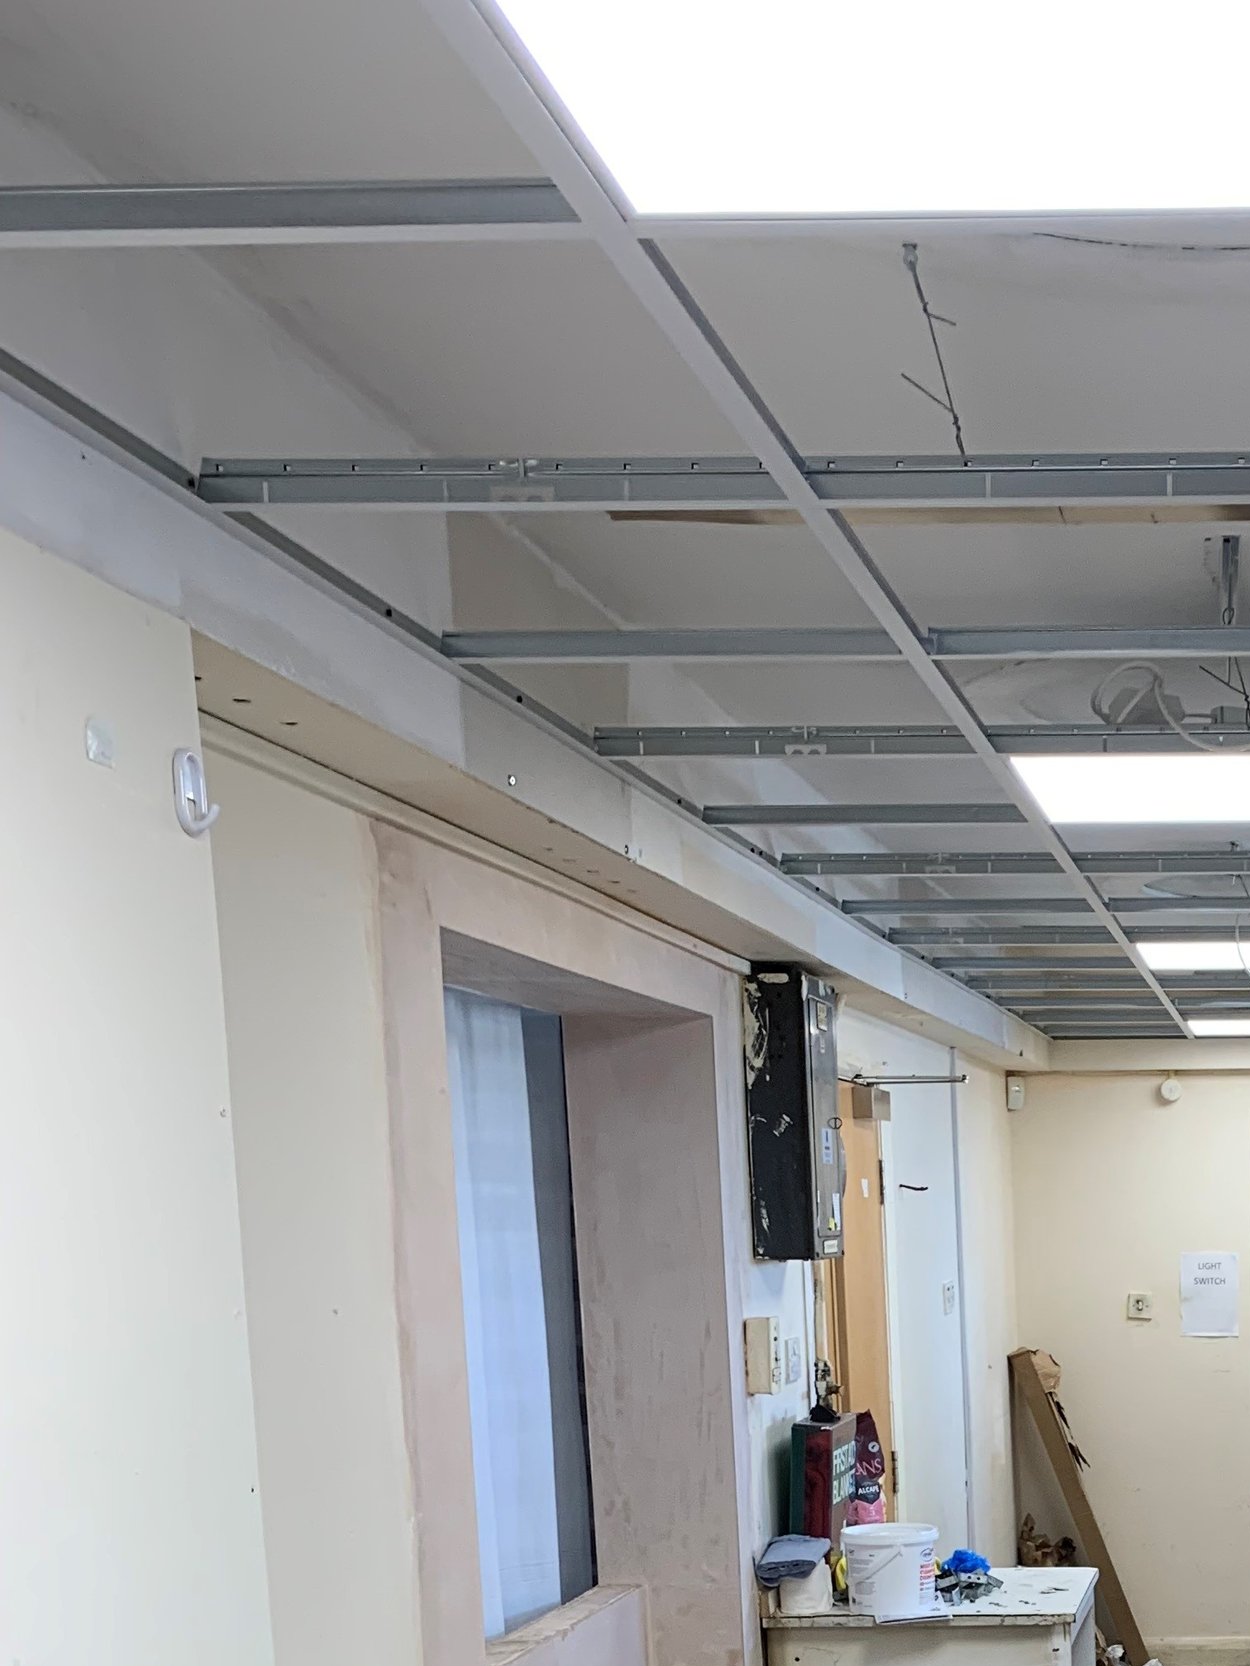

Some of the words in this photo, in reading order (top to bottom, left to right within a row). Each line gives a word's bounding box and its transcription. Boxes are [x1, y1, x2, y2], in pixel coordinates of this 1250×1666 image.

[1198, 1262, 1222, 1270] LIGHT
[1193, 1277, 1226, 1285] SWITCH
[833, 1444, 848, 1475] FIRST
[856, 1458, 882, 1475] ANS
